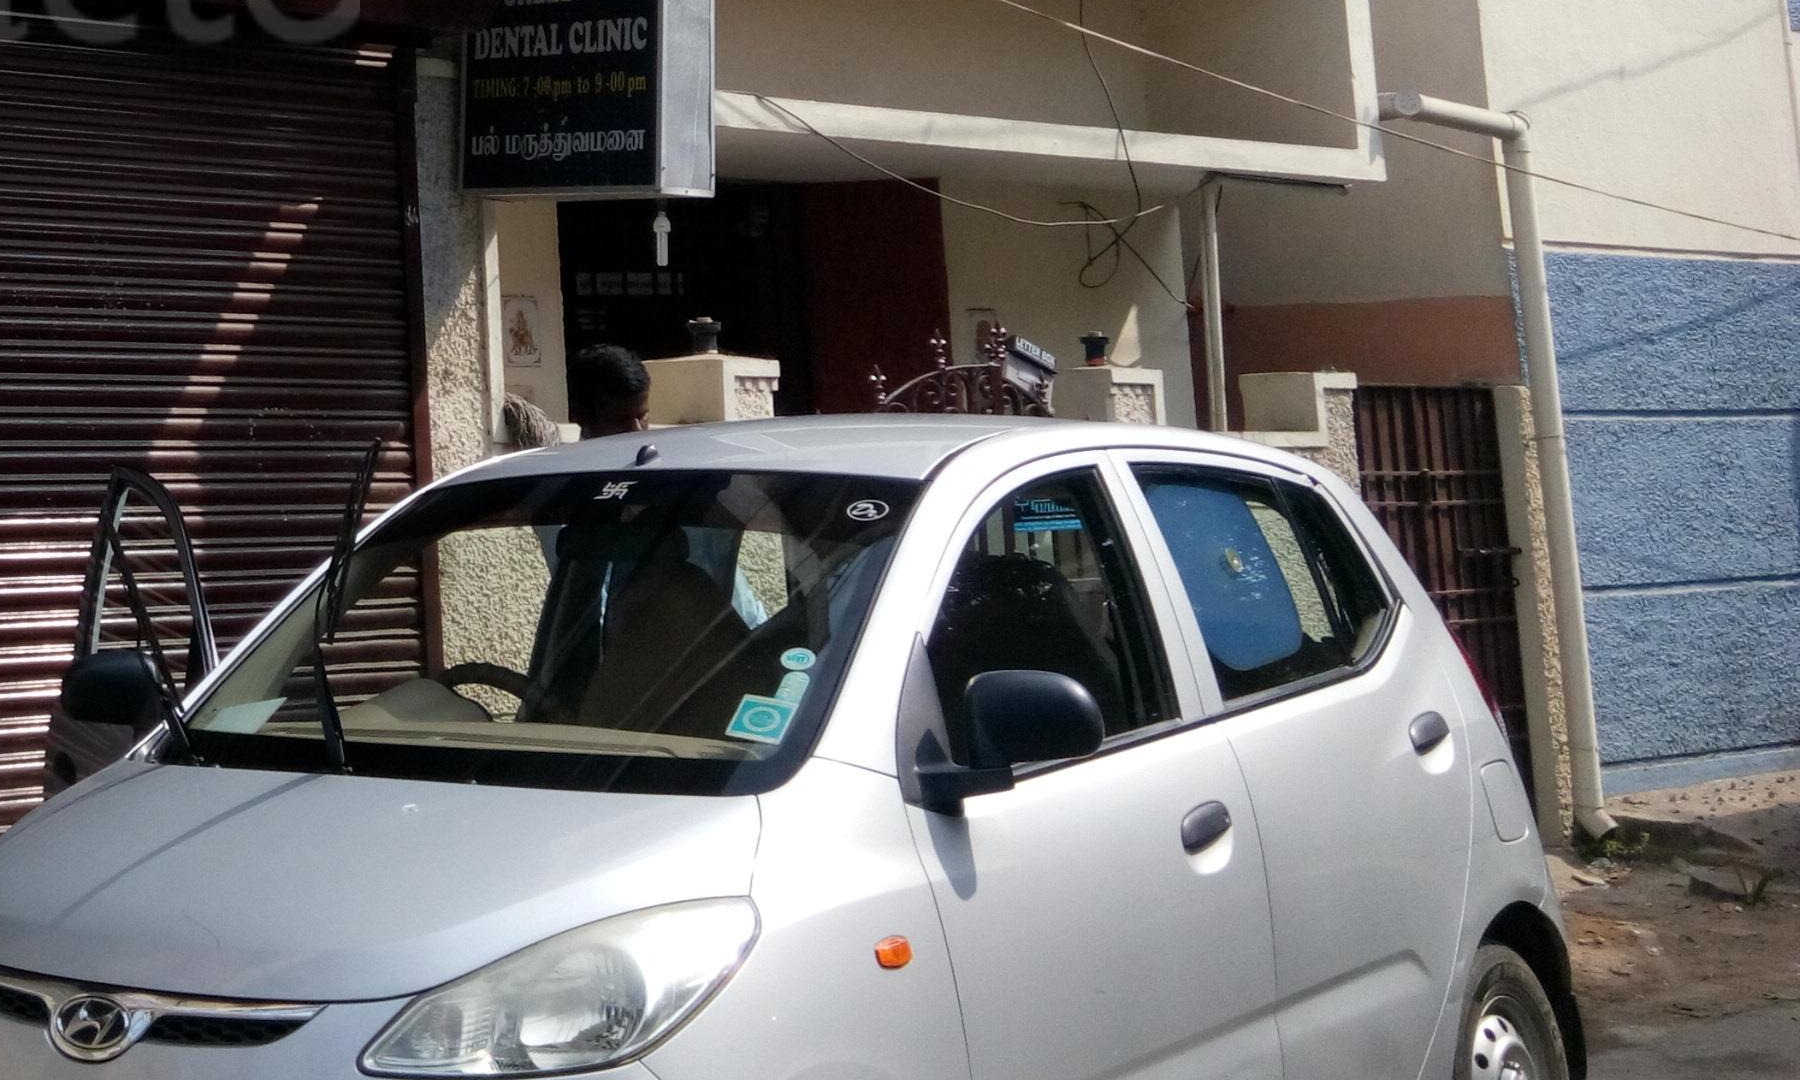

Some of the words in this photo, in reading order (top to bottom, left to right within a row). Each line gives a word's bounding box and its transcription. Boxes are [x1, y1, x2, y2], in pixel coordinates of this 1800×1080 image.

[474, 23, 563, 60] DENTAL
[568, 16, 648, 54] CLINIC
[578, 74, 589, 94] to
